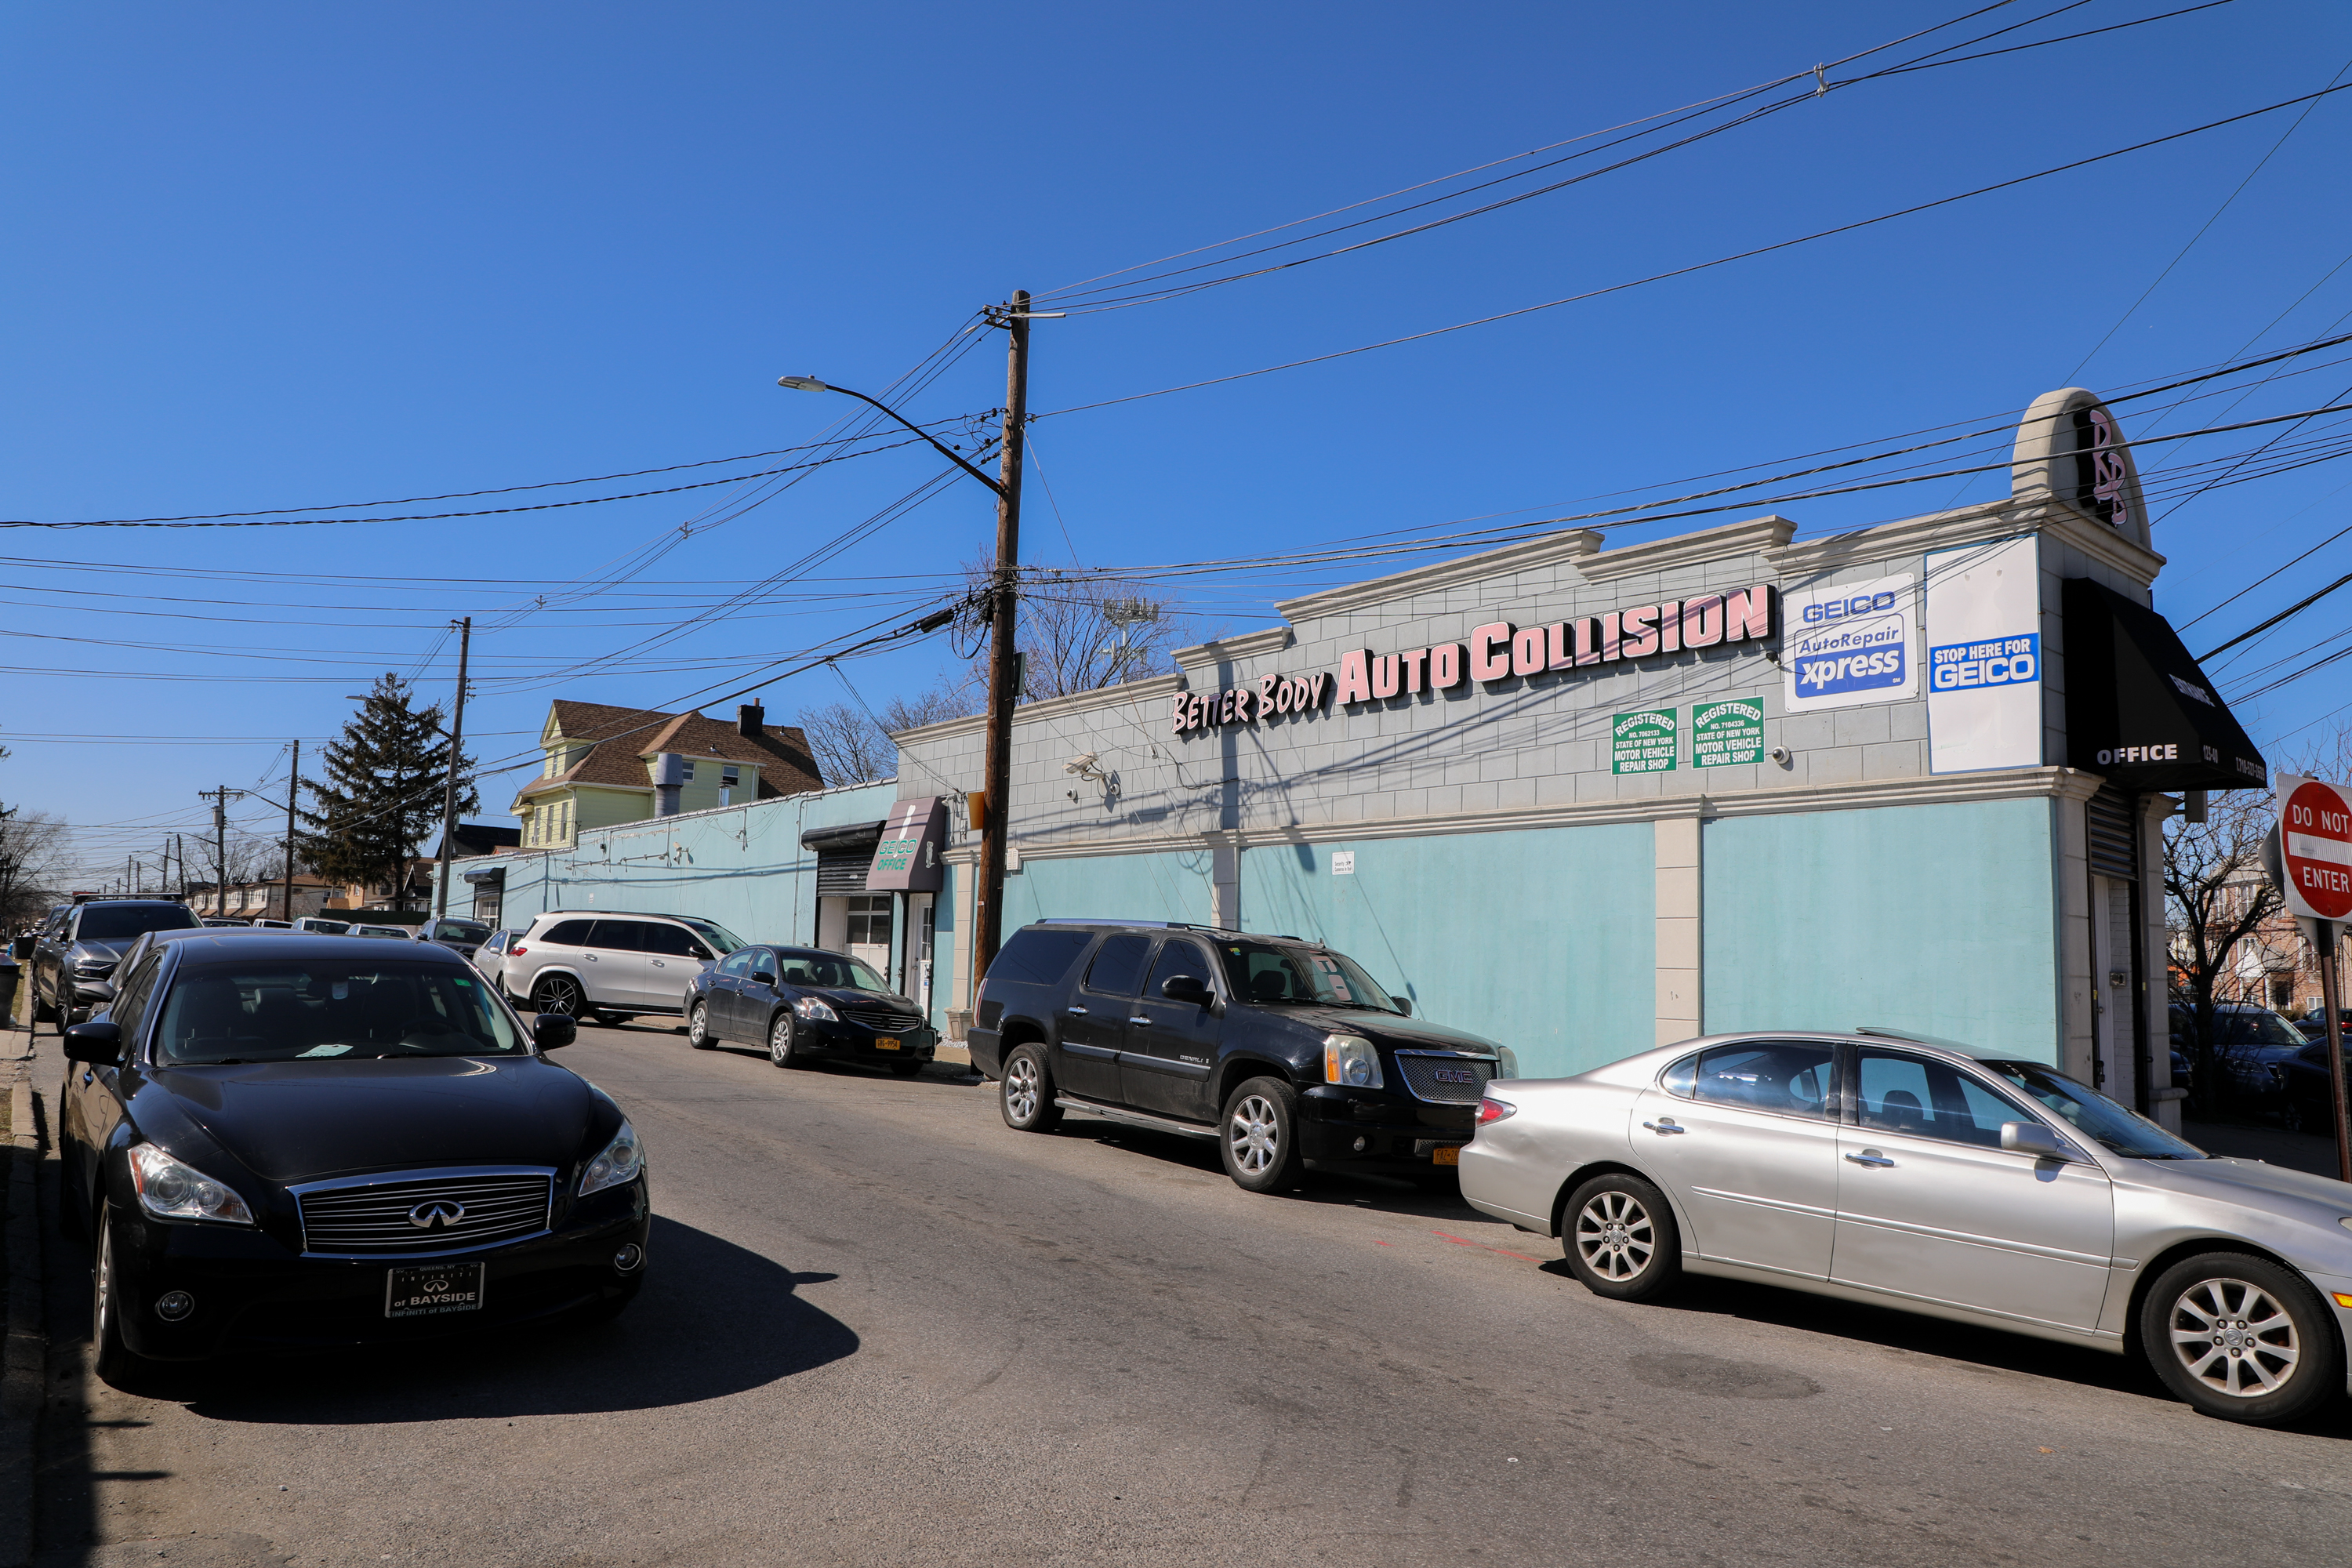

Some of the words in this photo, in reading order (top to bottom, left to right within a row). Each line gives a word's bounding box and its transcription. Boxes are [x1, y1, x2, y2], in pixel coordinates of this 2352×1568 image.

[1803, 590, 1896, 623] GEICO
[1798, 626, 1900, 654] AutoRepair
[1171, 688, 1250, 735] BETTER
[1257, 671, 1327, 720] BODY
[1335, 641, 1461, 706] AUTO
[1469, 583, 1770, 684] COLLISION
[1934, 647, 1966, 664] STOP
[1969, 642, 2002, 662] HERE
[2005, 637, 2031, 656] FOR
[1800, 649, 1900, 690] xpress
[1934, 653, 2035, 689] GEICO
[1695, 702, 1762, 729] REGISTERED
[1614, 713, 1675, 737] REGISTERED
[1615, 740, 1633, 750] STATE
[1642, 738, 1657, 746] NEW
[1657, 736, 1674, 746] YORK
[1696, 732, 1715, 742] STATE
[1716, 731, 1725, 739] OF
[1726, 729, 1740, 738] NEW
[1742, 727, 1760, 736] YORK
[1614, 749, 1641, 761] MOTOR
[1642, 746, 1675, 759] VEHICLE
[1695, 741, 1724, 754] MOTOR
[1726, 736, 1762, 751] VEHICLE
[2096, 743, 2178, 765] OFFICE
[1620, 760, 1646, 772] REPAIR
[1647, 758, 1669, 771] SHOP
[1701, 752, 1730, 766] REPAIR
[1732, 750, 1755, 763] SHOP
[2292, 804, 2313, 827] DO
[2321, 810, 2349, 834] NOT
[878, 839, 917, 856] GEICO
[877, 858, 907, 871] OFFICE
[2303, 866, 2350, 894] ENTER
[1435, 1070, 1474, 1084] GMC
[401, 1272, 472, 1283] INFINITI
[410, 1292, 476, 1306] BAYSIDE
[392, 1308, 426, 1318] INFINITI
[439, 1304, 477, 1313] BAYSIDE
